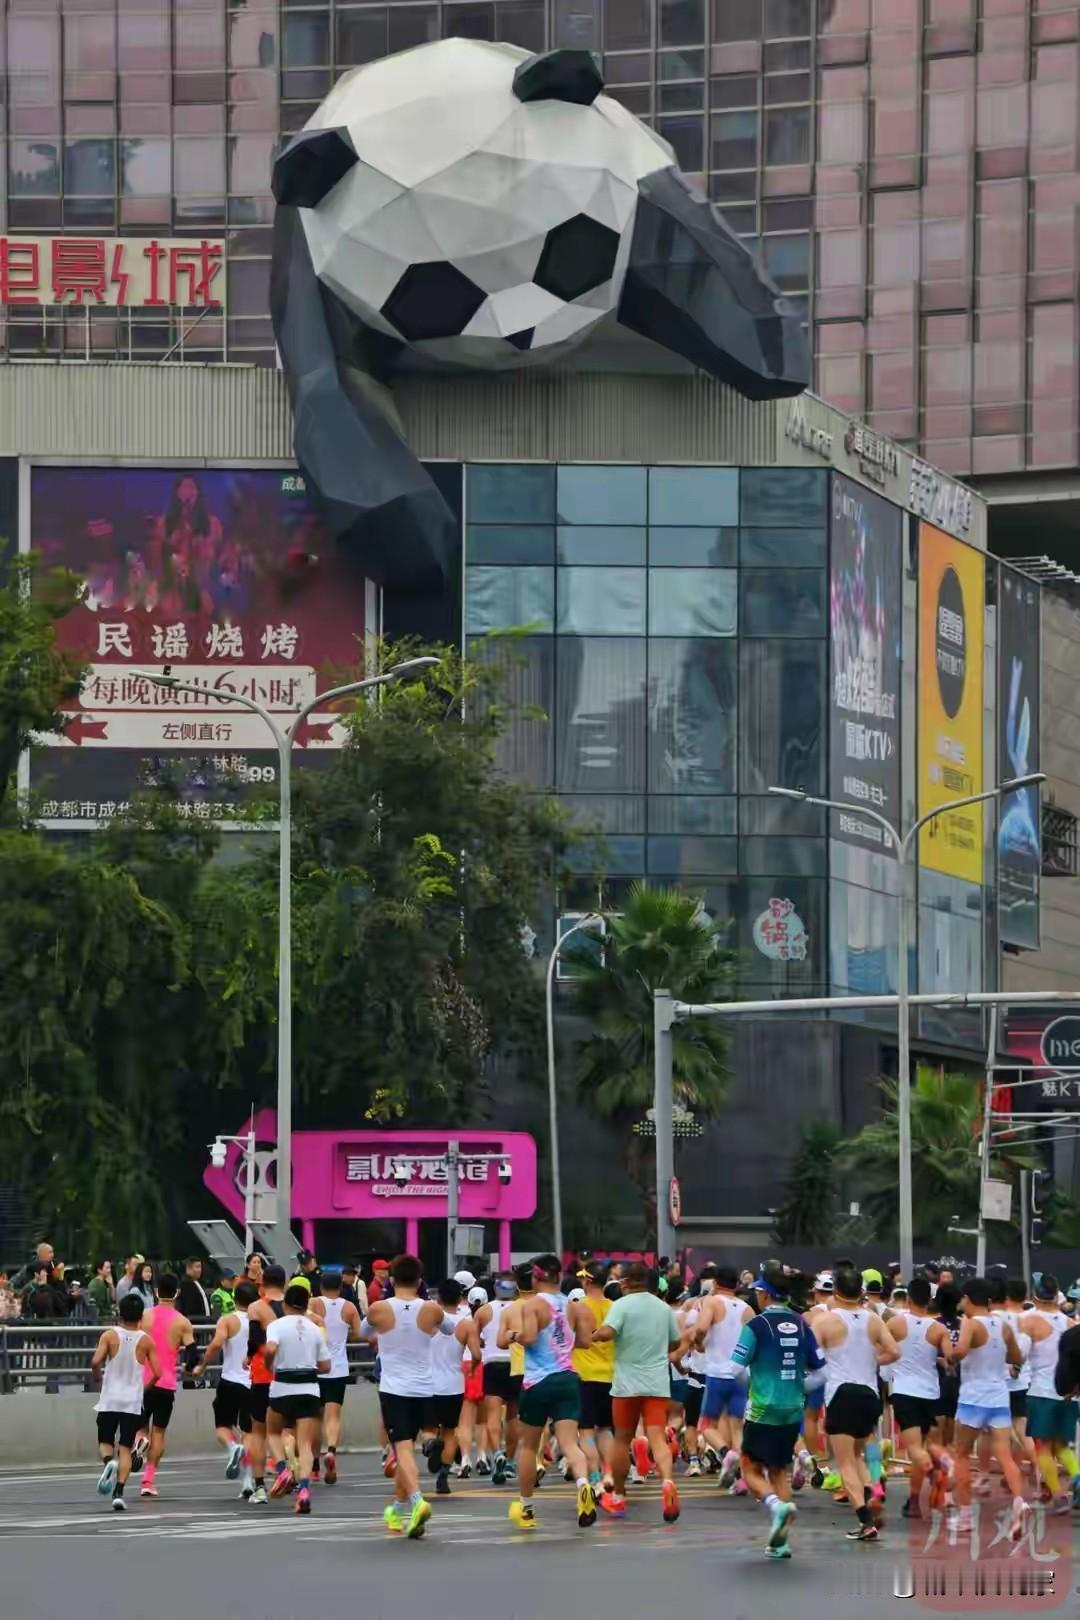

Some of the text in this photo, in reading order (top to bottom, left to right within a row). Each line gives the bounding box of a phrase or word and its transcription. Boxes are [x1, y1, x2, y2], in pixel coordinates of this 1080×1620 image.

[96, 621, 299, 659] 民谣烧烤
[92, 670, 296, 705] 每晚演出6小时
[162, 722, 233, 741] 左侧直行
